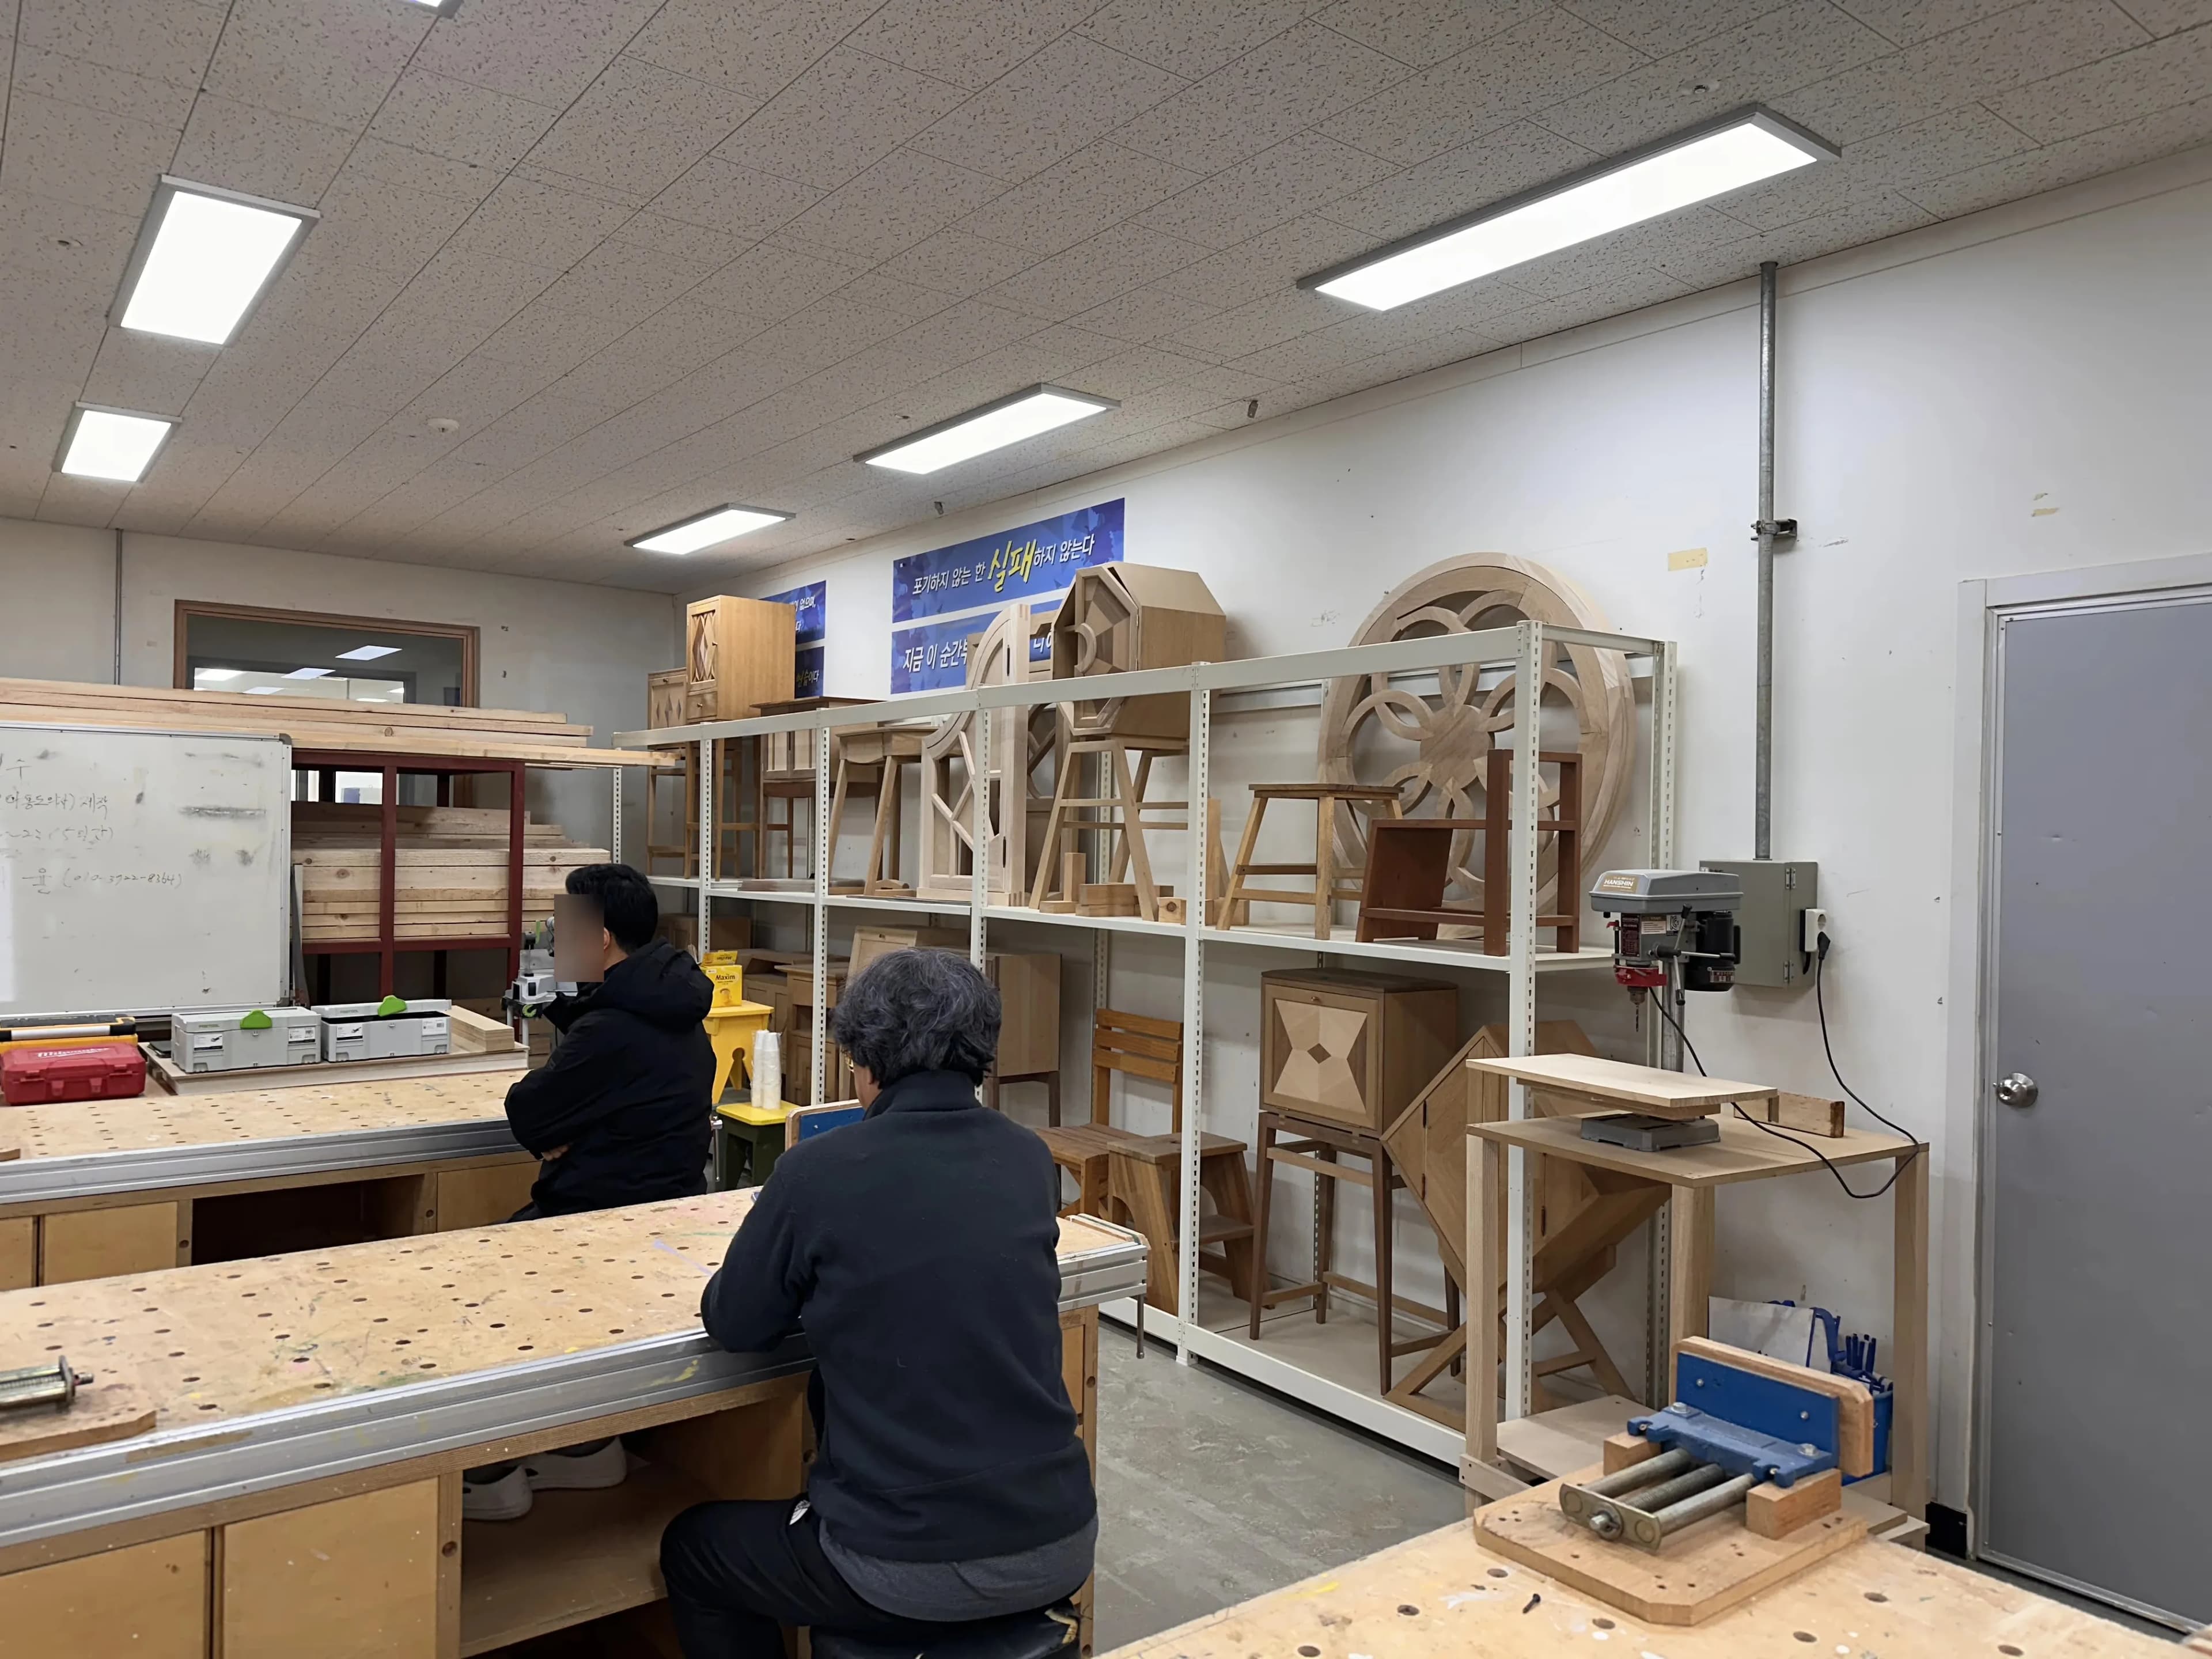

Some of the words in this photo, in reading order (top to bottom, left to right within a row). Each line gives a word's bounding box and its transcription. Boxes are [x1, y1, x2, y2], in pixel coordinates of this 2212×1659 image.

[912, 570, 950, 595] 포기하지
[952, 566, 972, 588] 않는
[975, 562, 986, 582] 한
[1059, 533, 1095, 563] 않는다
[903, 646, 924, 673] 지금
[926, 643, 938, 670] 이
